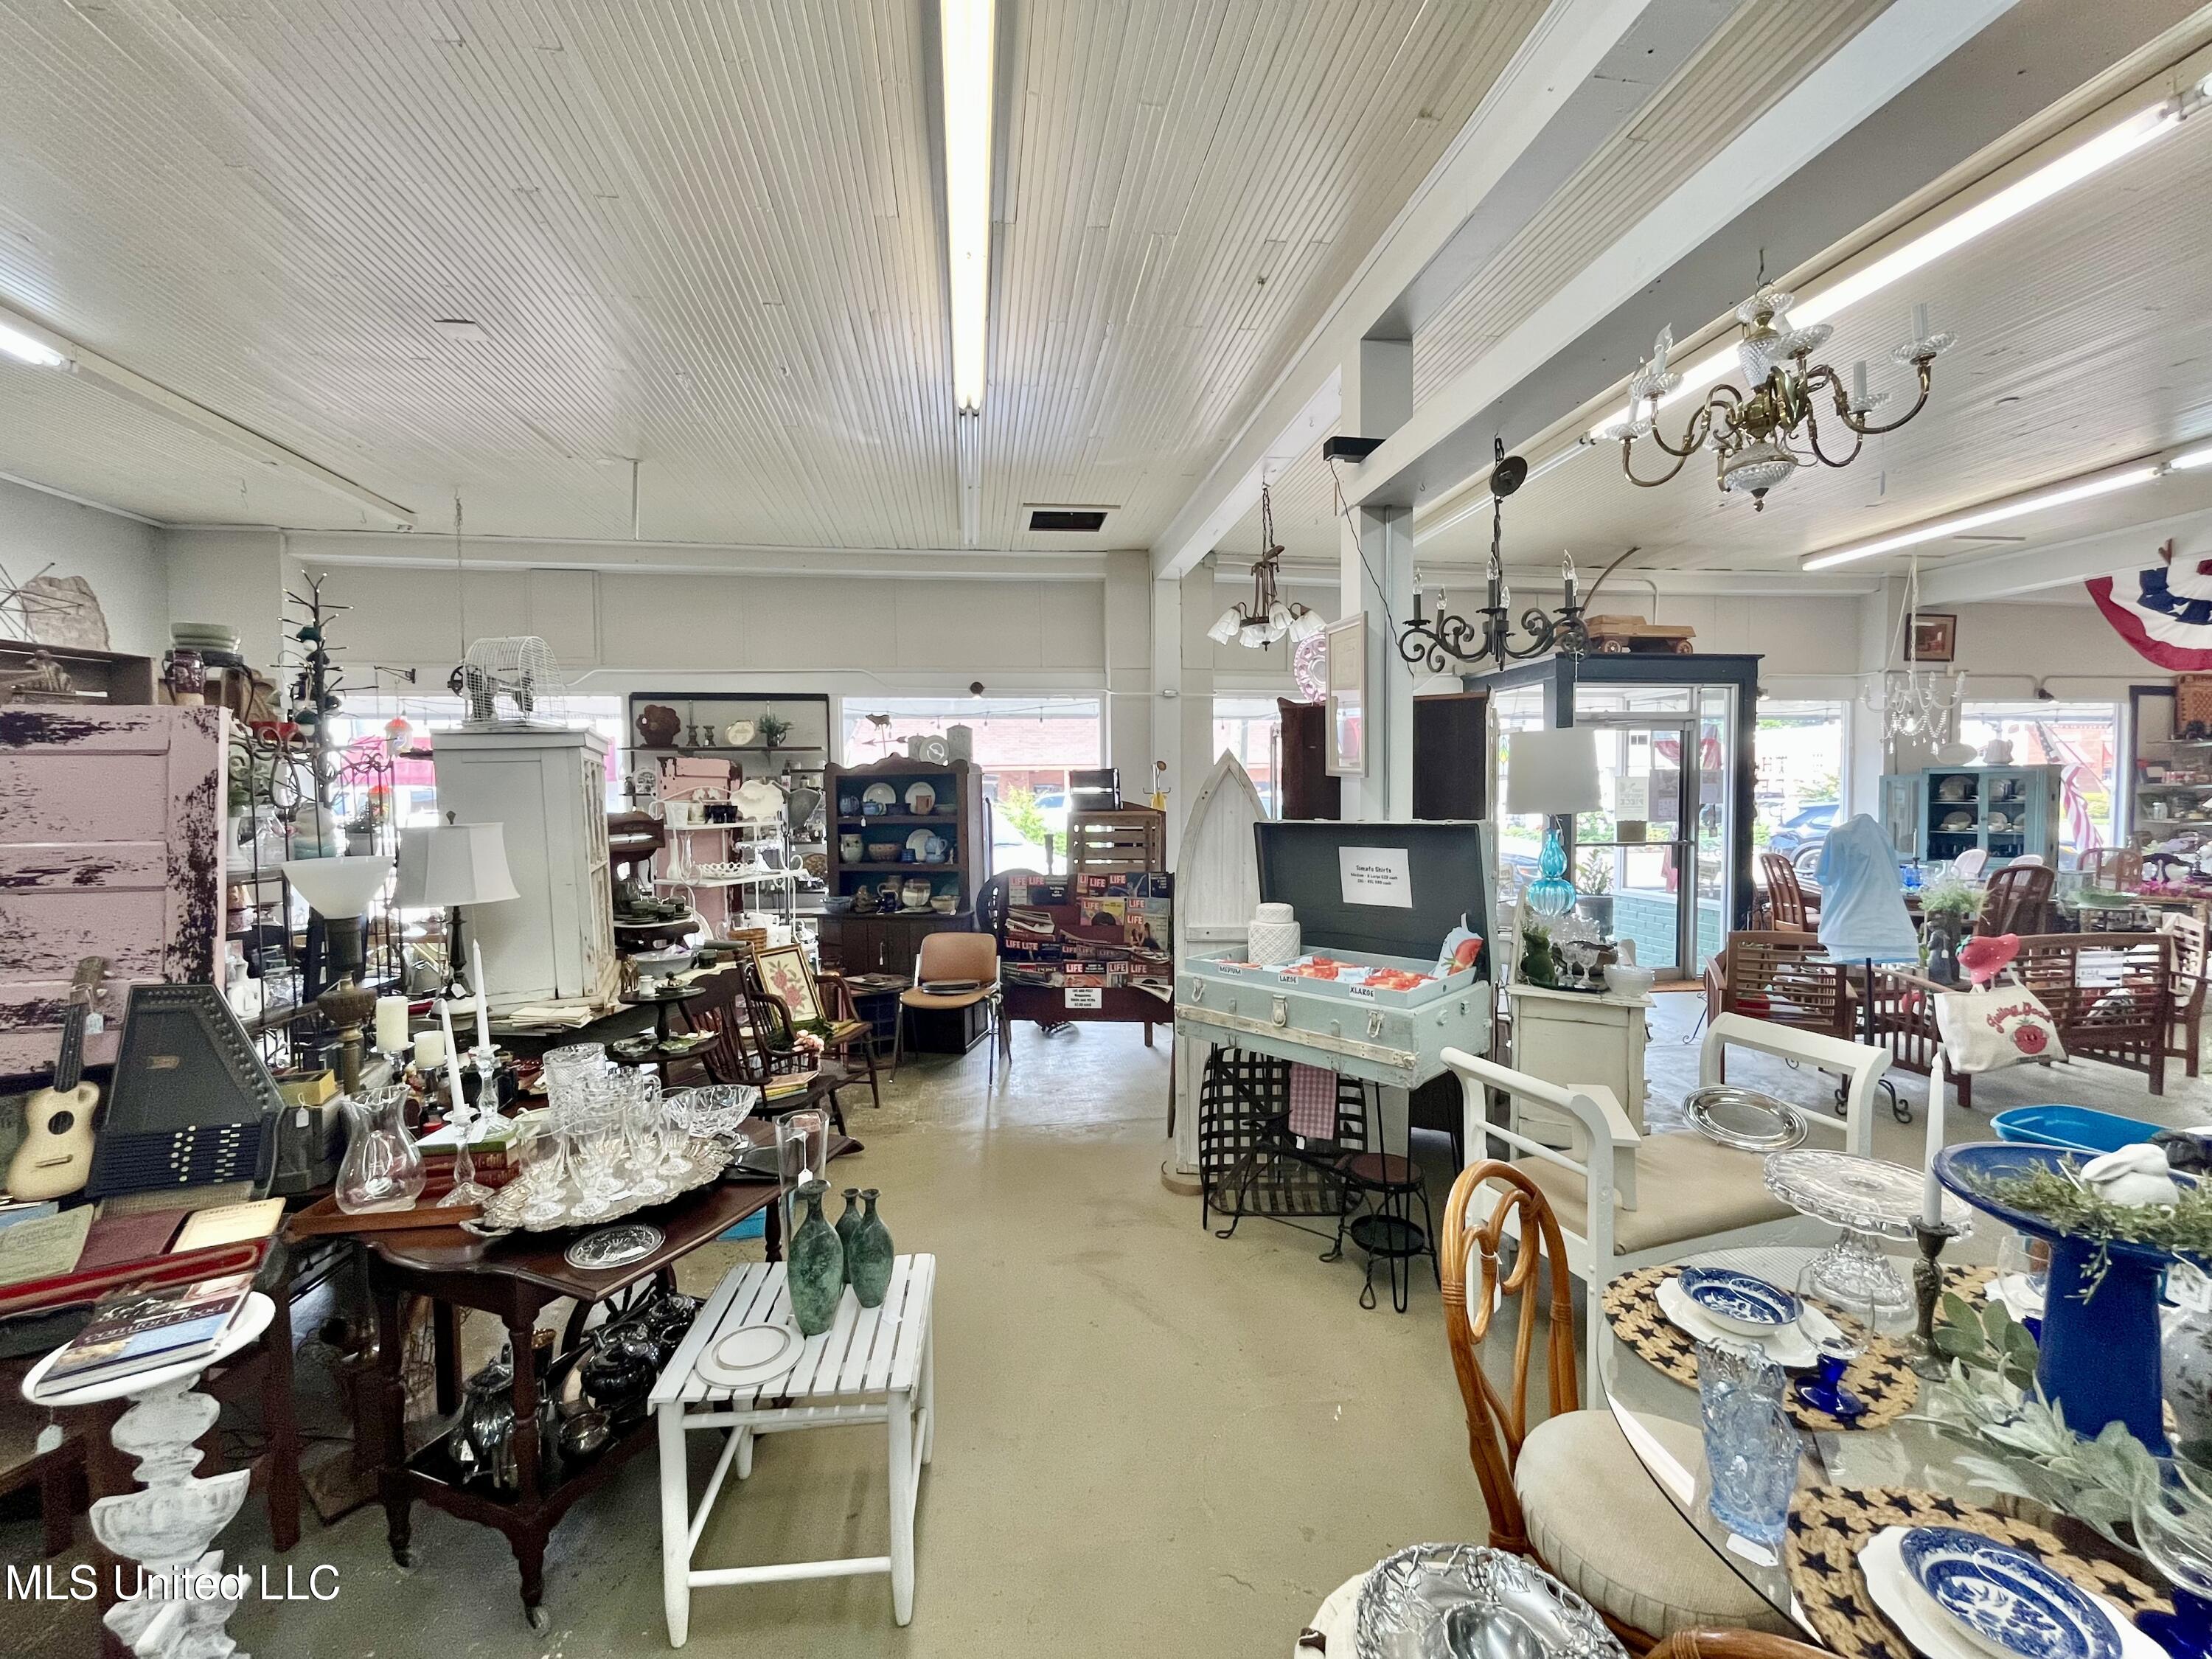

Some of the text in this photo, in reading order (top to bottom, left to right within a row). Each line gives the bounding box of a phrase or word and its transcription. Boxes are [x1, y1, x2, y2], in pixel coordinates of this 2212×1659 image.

[1011, 877, 1026, 886] LIFE
[1029, 877, 1045, 885] LIFE
[1080, 875, 1089, 884] LI
[1090, 878, 1106, 888] LIFE
[1110, 874, 1126, 884] LIFE
[1083, 901, 1099, 909] LIFE
[1129, 900, 1145, 908] LIFE
[1127, 915, 1143, 925] LIFE
[1006, 939, 1021, 949] LIFE
[1022, 942, 1038, 950] LIFE
[1062, 945, 1077, 953] LIFE
[1065, 964, 1083, 973] LIFE
[1109, 963, 1126, 972] LIFE
[1130, 964, 1147, 973] LIFE
[1219, 965, 1242, 975] MEDIUM
[1279, 975, 1297, 984] LARGE
[1349, 986, 1374, 998] XLARGE
